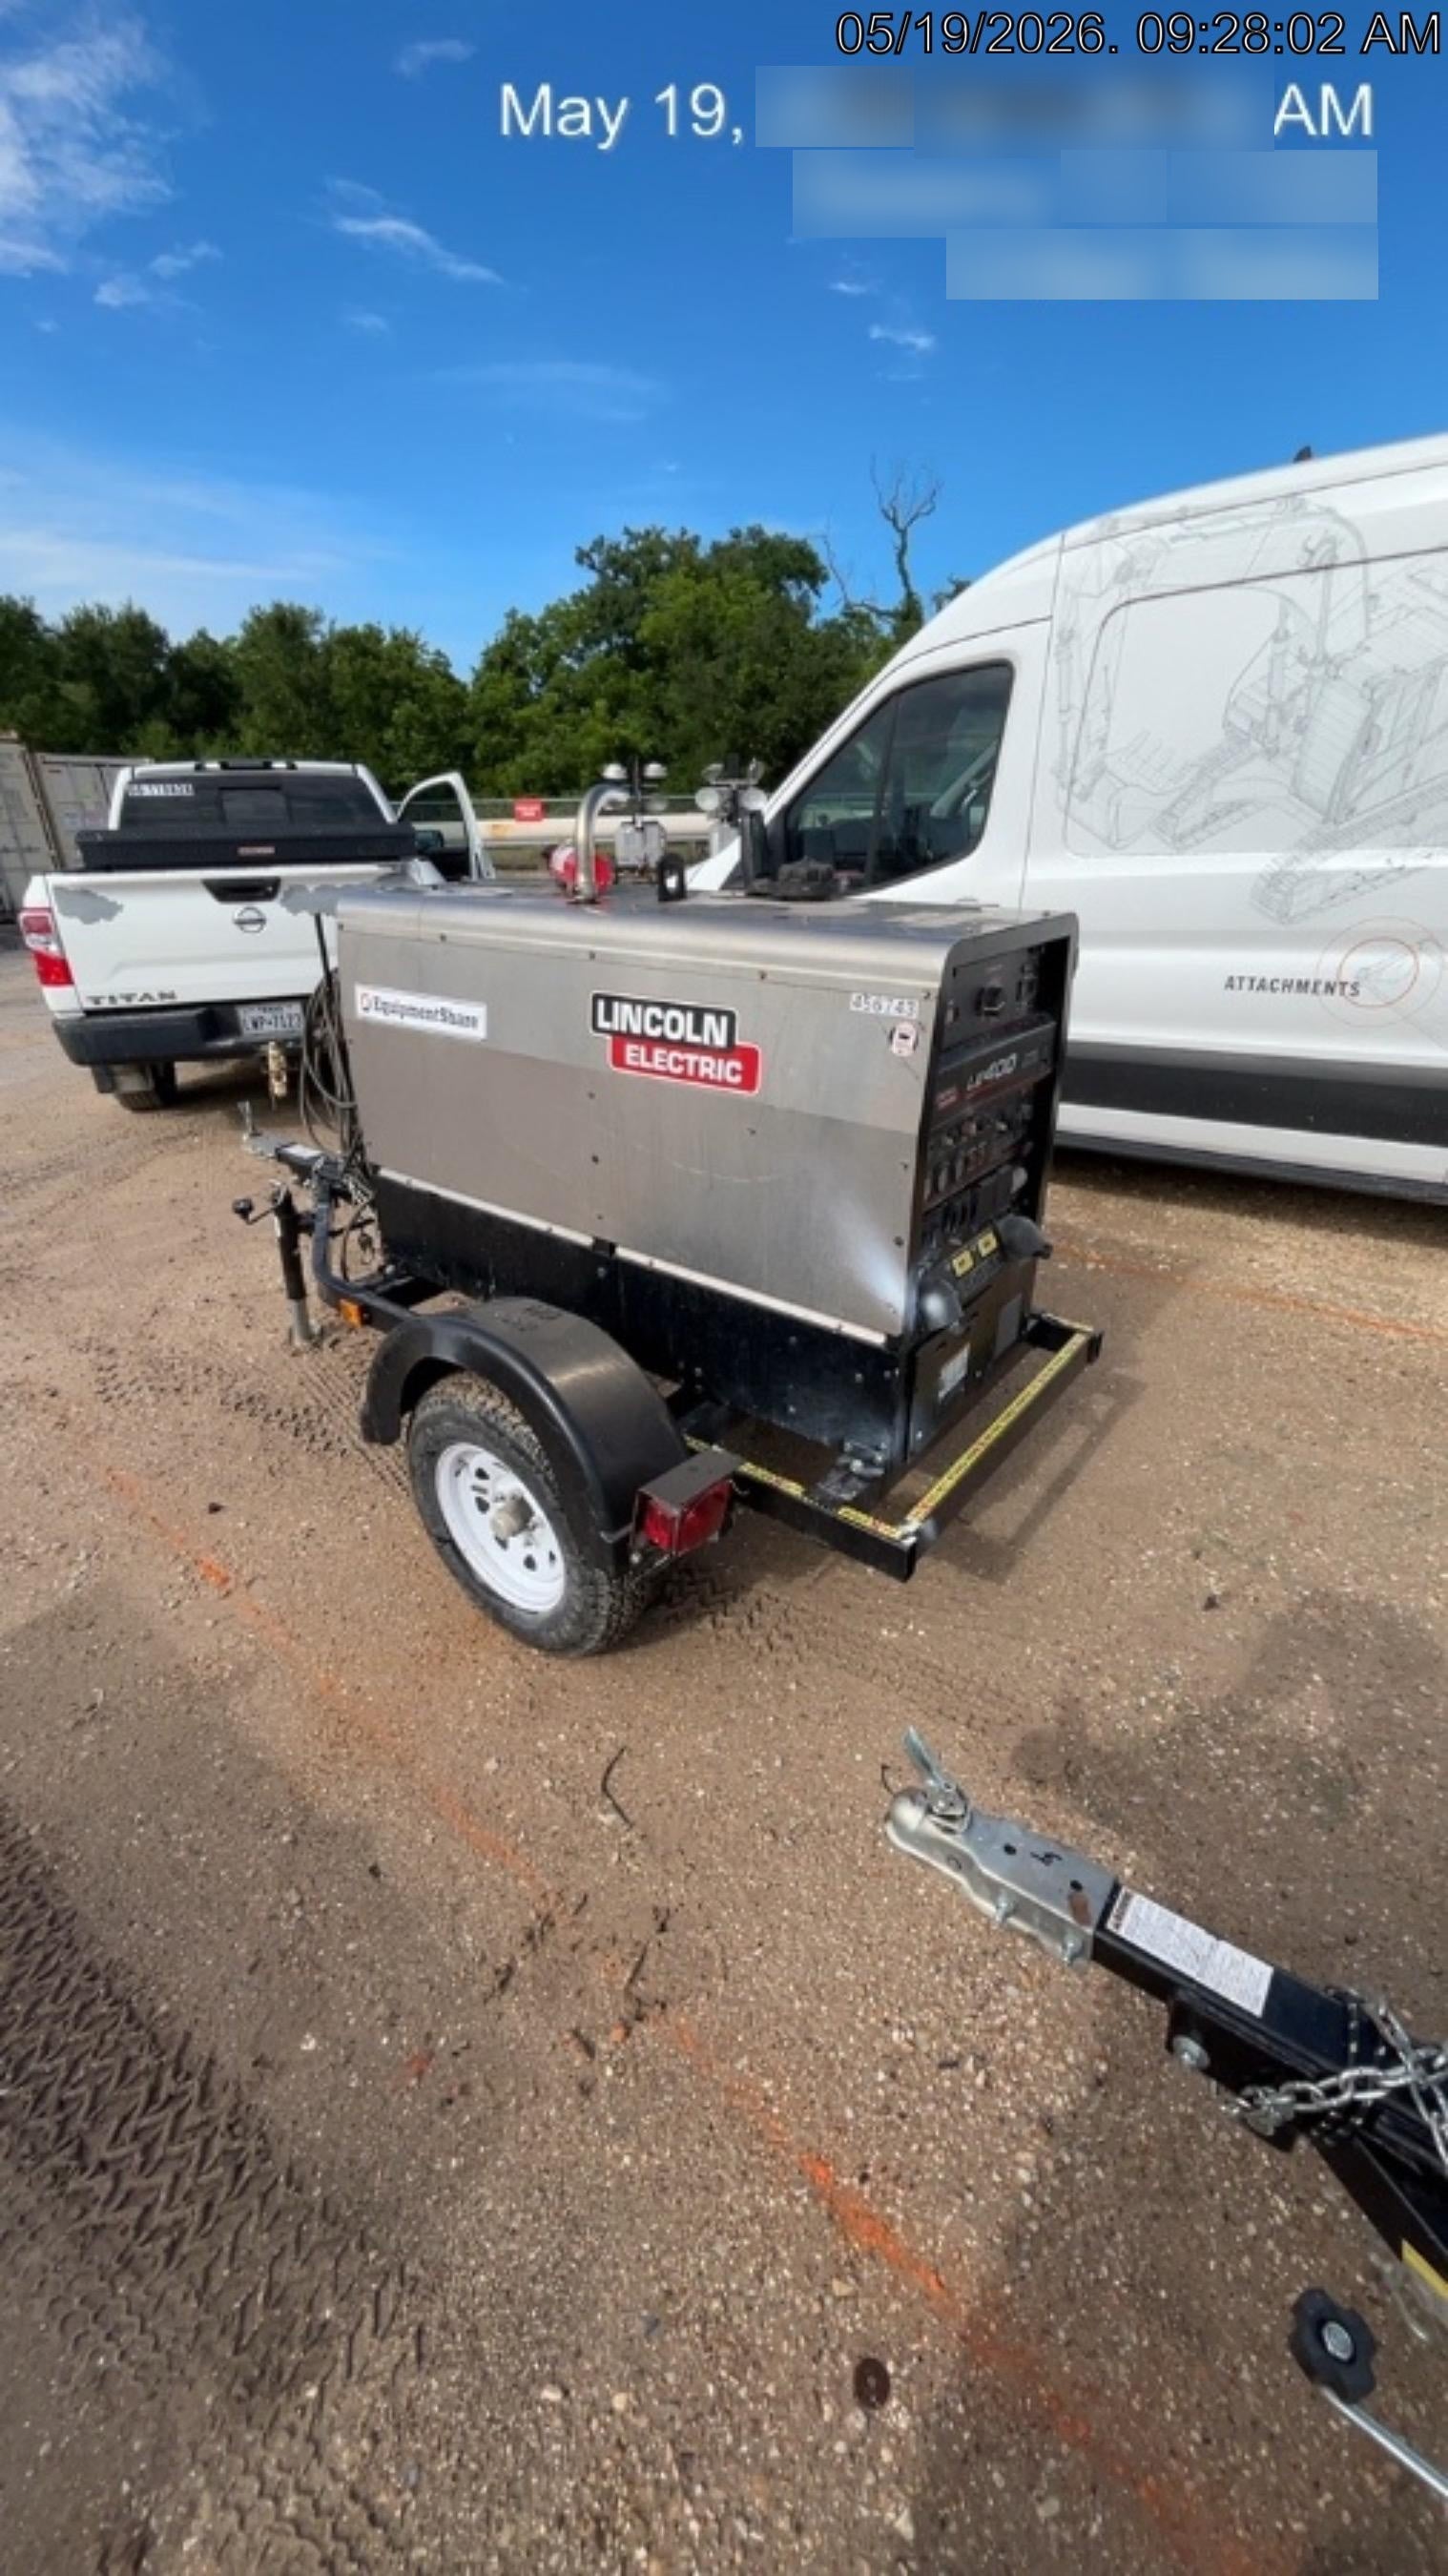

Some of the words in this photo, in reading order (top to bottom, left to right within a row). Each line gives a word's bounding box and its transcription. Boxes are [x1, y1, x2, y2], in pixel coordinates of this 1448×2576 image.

[86, 990, 176, 1006] TITAN
[1224, 975, 1360, 997] ATTACHMENTS
[374, 995, 478, 1029] EquipmentShare
[596, 999, 728, 1048] LINCOLN
[625, 1044, 742, 1084] ELECTRIC
